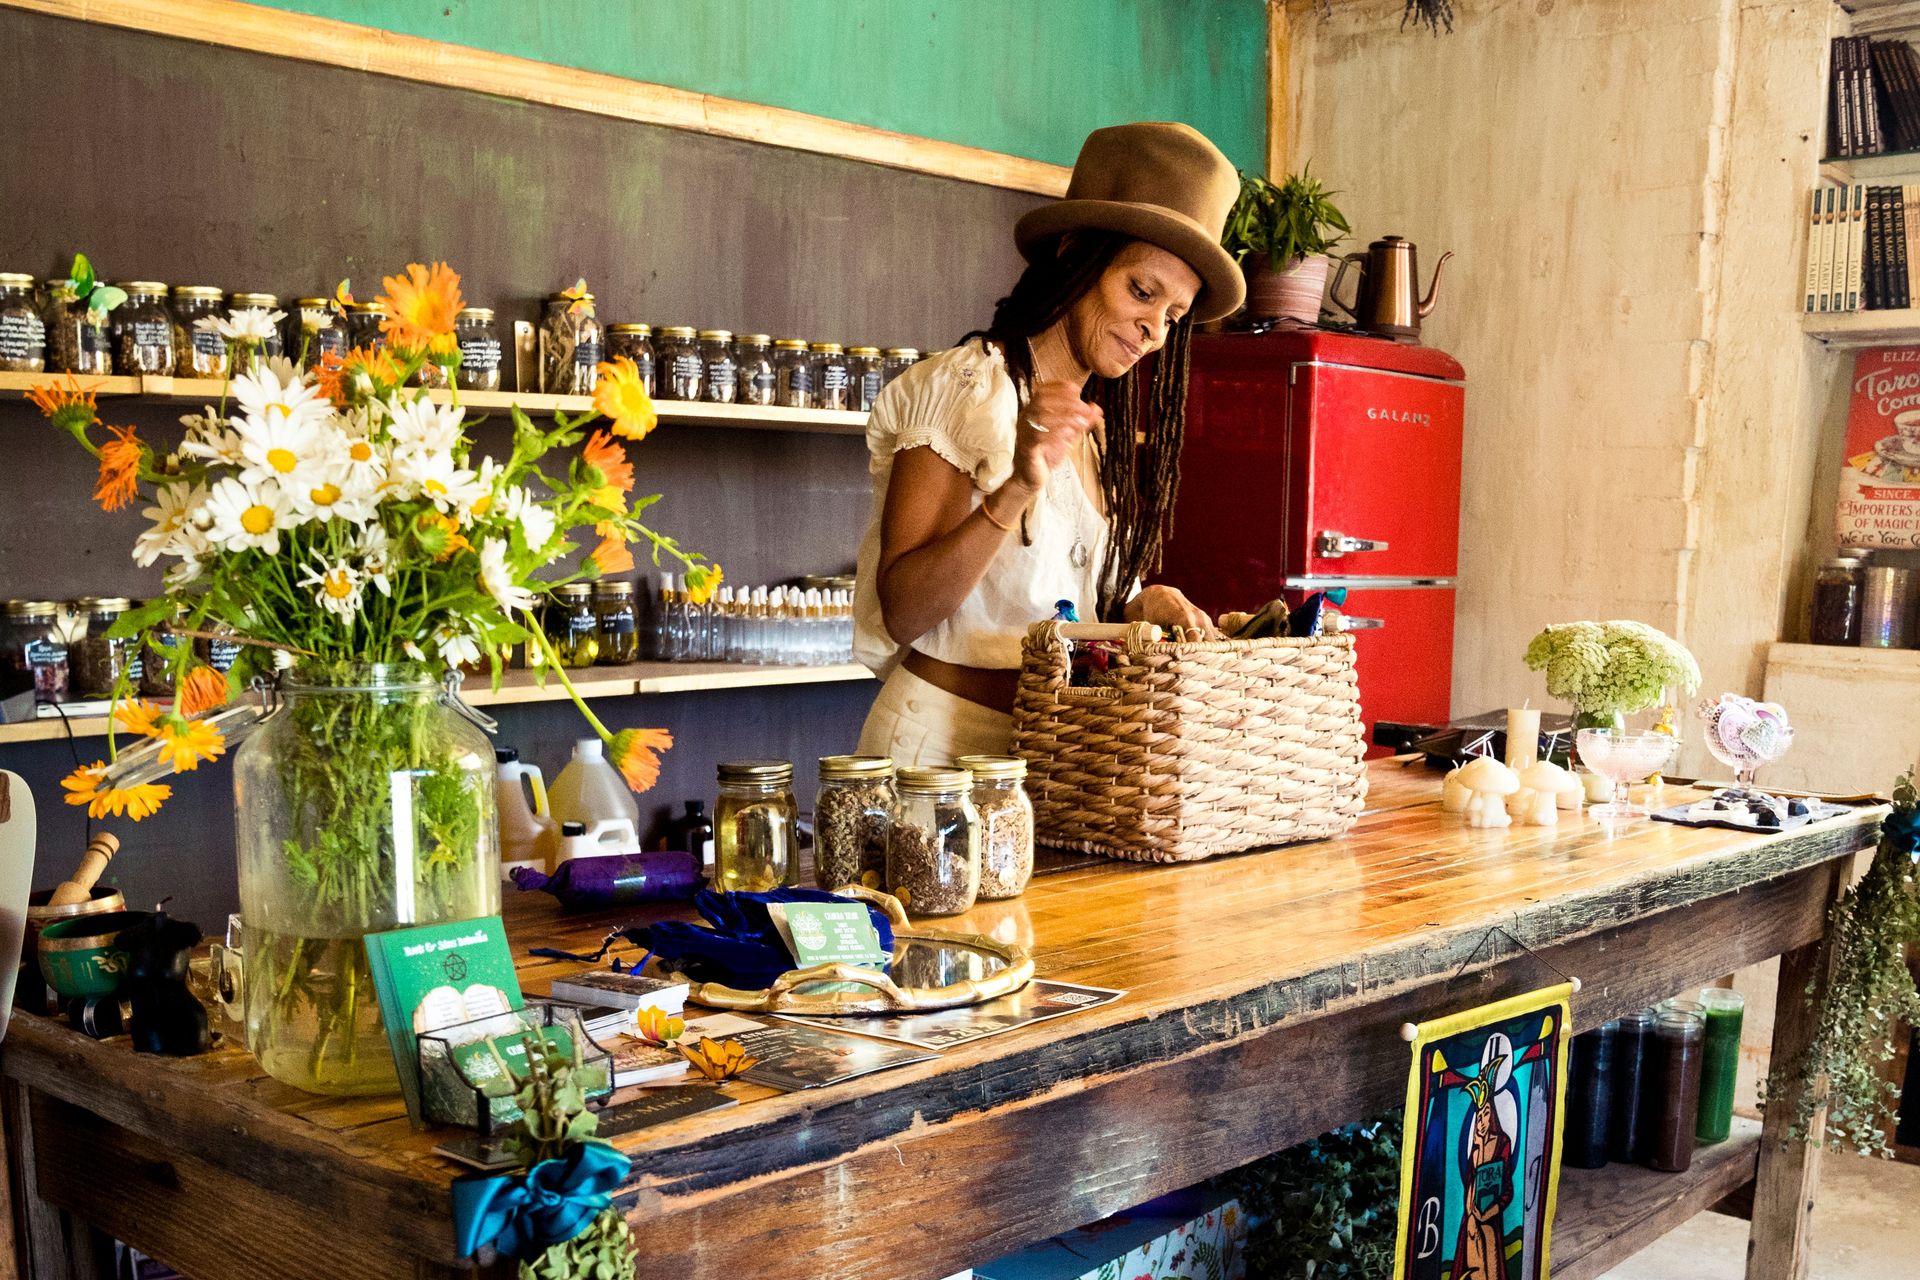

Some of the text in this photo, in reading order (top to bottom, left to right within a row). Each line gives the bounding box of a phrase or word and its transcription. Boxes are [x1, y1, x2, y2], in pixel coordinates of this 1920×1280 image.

[1870, 211, 1880, 264] PURE MAGIC
[1883, 211, 1894, 264] PURE MAGIC
[1895, 210, 1905, 264] PURE MAGIC
[1808, 263, 1817, 290] TAROT
[1821, 262, 1830, 290] TAROT
[1835, 261, 1845, 288] TAROT
[1848, 260, 1858, 287] TAROT
[1367, 407, 1431, 428] GALANZ
[1840, 501, 1913, 517] IMPORTERS
[1854, 518, 1912, 530] OF MAGIC
[1878, 530, 1906, 546] Your
[1417, 1196, 1441, 1260] B
